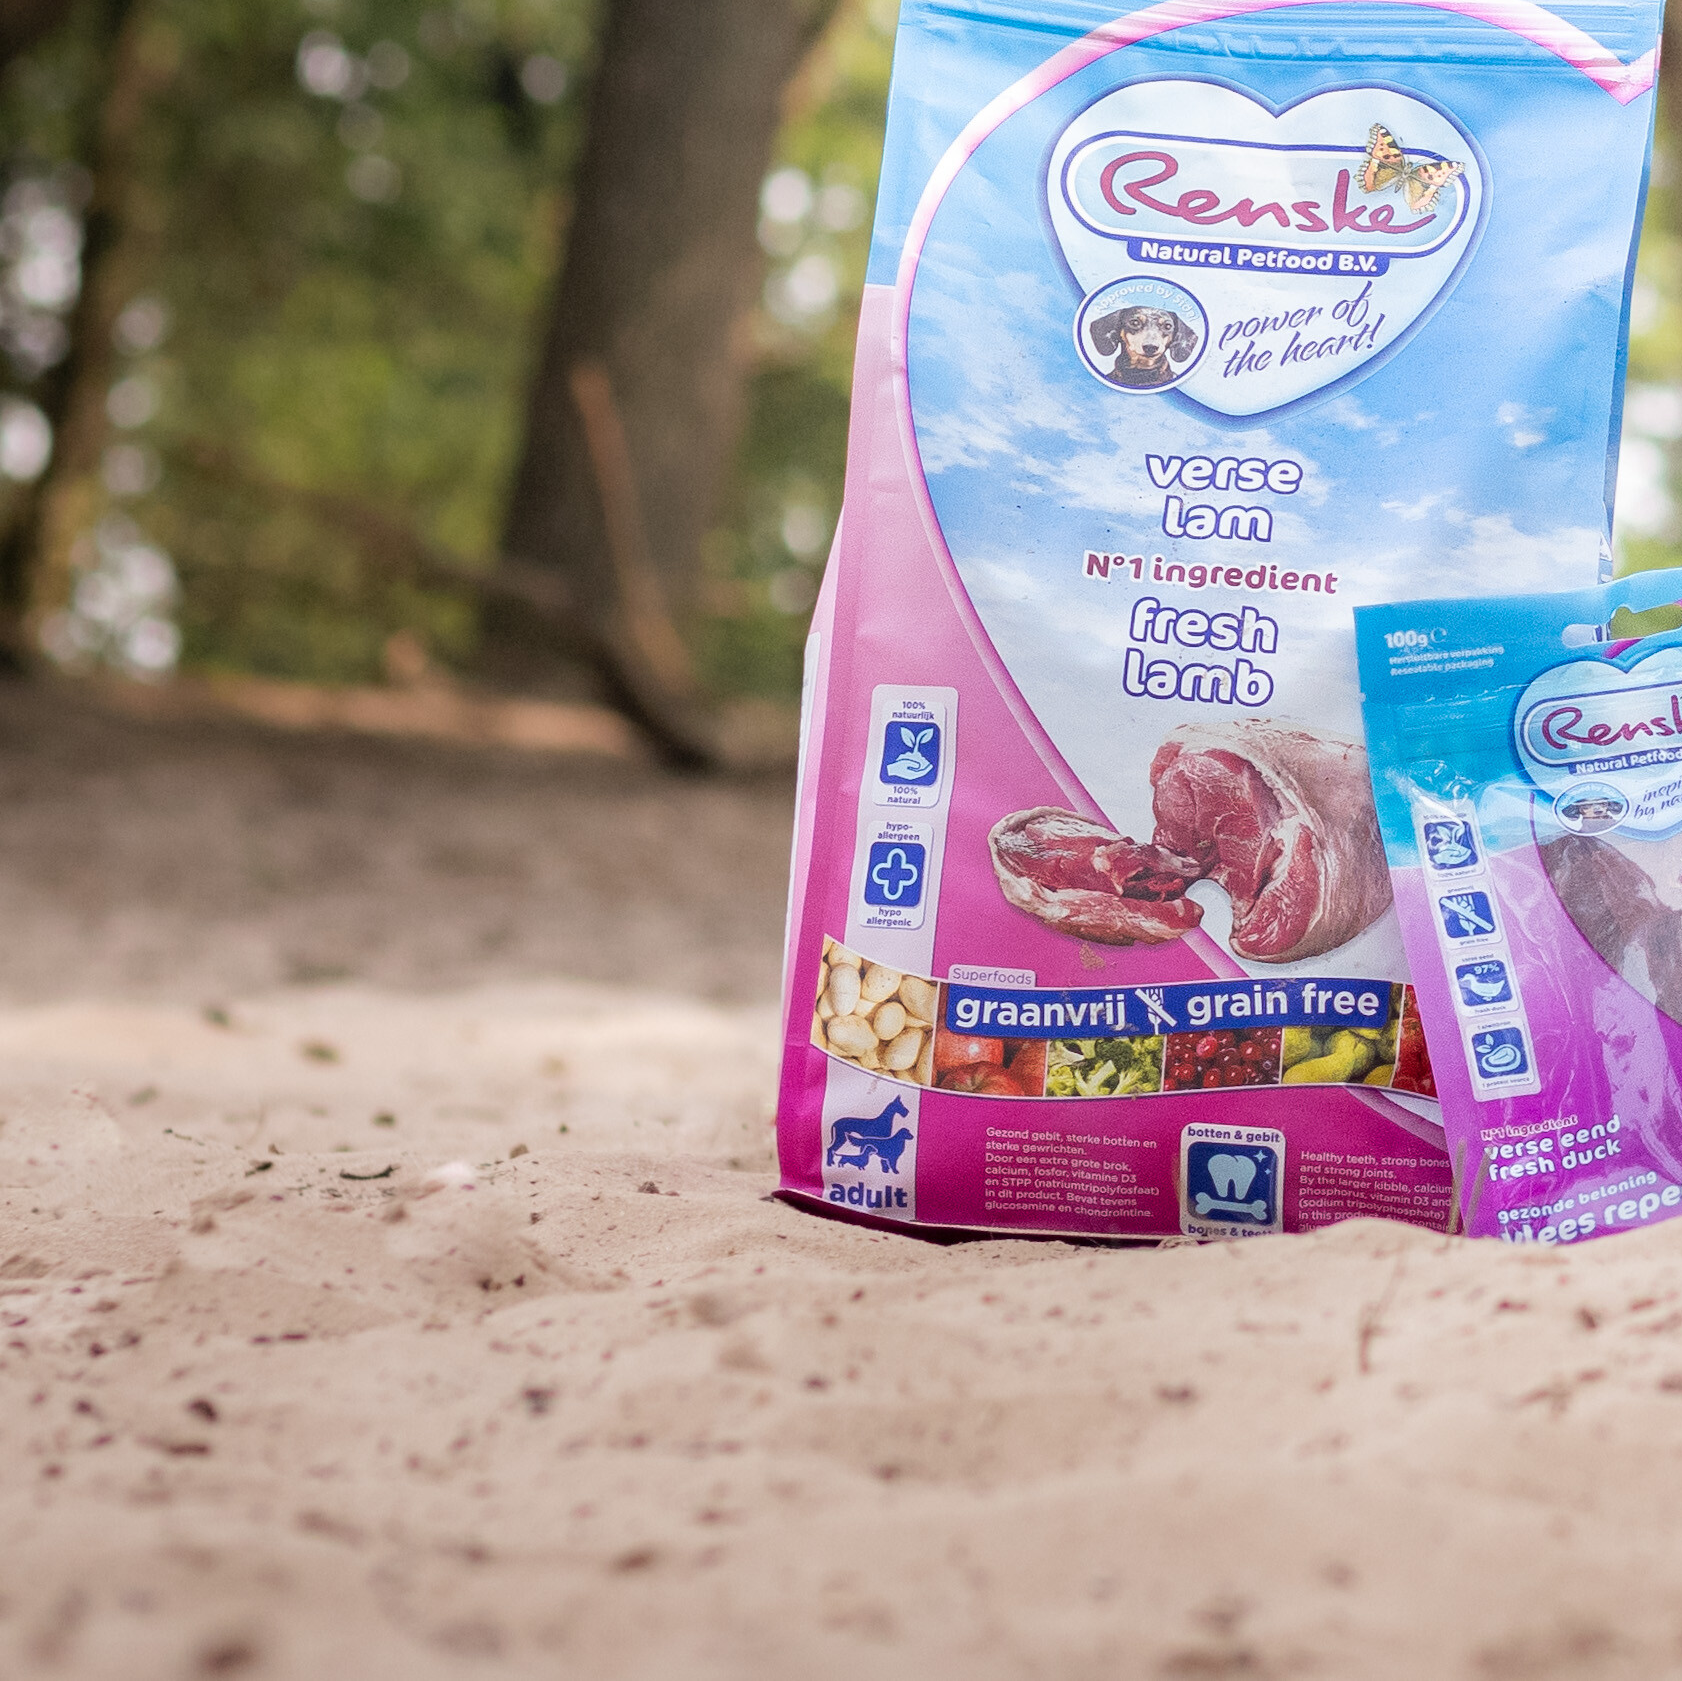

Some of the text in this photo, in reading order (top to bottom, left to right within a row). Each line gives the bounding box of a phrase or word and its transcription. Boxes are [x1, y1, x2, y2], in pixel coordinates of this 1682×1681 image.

[1099, 151, 1437, 234] Renske
[1140, 240, 1378, 273] Natural Petfood B.V.
[1156, 285, 1174, 300] by
[1218, 280, 1372, 350] power of
[1221, 313, 1386, 378] the heart!
[1145, 454, 1303, 495] verse
[1162, 495, 1273, 542] lam
[1152, 556, 1338, 594] ingredient
[1129, 597, 1279, 654] fresh
[1384, 630, 1429, 648] 100g
[1123, 648, 1274, 707] lamb
[902, 701, 926, 709] 100%
[892, 711, 934, 720] natuurlijk
[1575, 756, 1628, 774] Natural
[893, 786, 918, 795] 100%
[887, 796, 921, 804] natural
[1634, 803, 1656, 821] by
[886, 822, 913, 831] hypo-
[878, 831, 920, 841] allergeen
[877, 907, 902, 918] hypo
[866, 918, 912, 927] allergenic
[952, 967, 1033, 986] Superfoods
[1474, 962, 1500, 975] 97%
[955, 983, 1380, 1031] graanvrij grain free
[1188, 1126, 1280, 1143] botten & gebit
[1506, 1114, 1578, 1138] ingredient
[986, 1127, 1157, 1149] Gezond gebit, sterke botten en
[1484, 1114, 1622, 1161] verse eend
[985, 1141, 1087, 1156] sterke gewrichten.
[985, 1153, 1132, 1172] Door een extra grote brok,
[1301, 1151, 1344, 1165] Healthy
[1346, 1154, 1378, 1166] teeth,
[1381, 1155, 1417, 1167] strong
[1488, 1138, 1622, 1182] fresh duck
[985, 1166, 1137, 1184] calcium, fosfor, vitamine D3
[1299, 1164, 1397, 1179] and strong joints.
[985, 1178, 999, 1186] en
[1001, 1178, 1032, 1187] STPP
[1299, 1176, 1313, 1186] By
[1317, 1176, 1335, 1185] the
[1338, 1178, 1372, 1189] larger
[1374, 1181, 1411, 1194] kibble,
[829, 1181, 908, 1209] adult
[985, 1189, 1137, 1206] in dit product. Bevat tevens
[1369, 1193, 1410, 1205] vitamin
[1413, 1196, 1429, 1206] D3
[1497, 1171, 1658, 1224] gezonde beloning
[985, 1200, 1072, 1213] glucosamine en
[1299, 1198, 1344, 1208] (sodium
[1346, 1199, 1445, 1220] tripolyphosphate)
[1315, 1210, 1331, 1220] this
[1230, 1227, 1238, 1237] &
